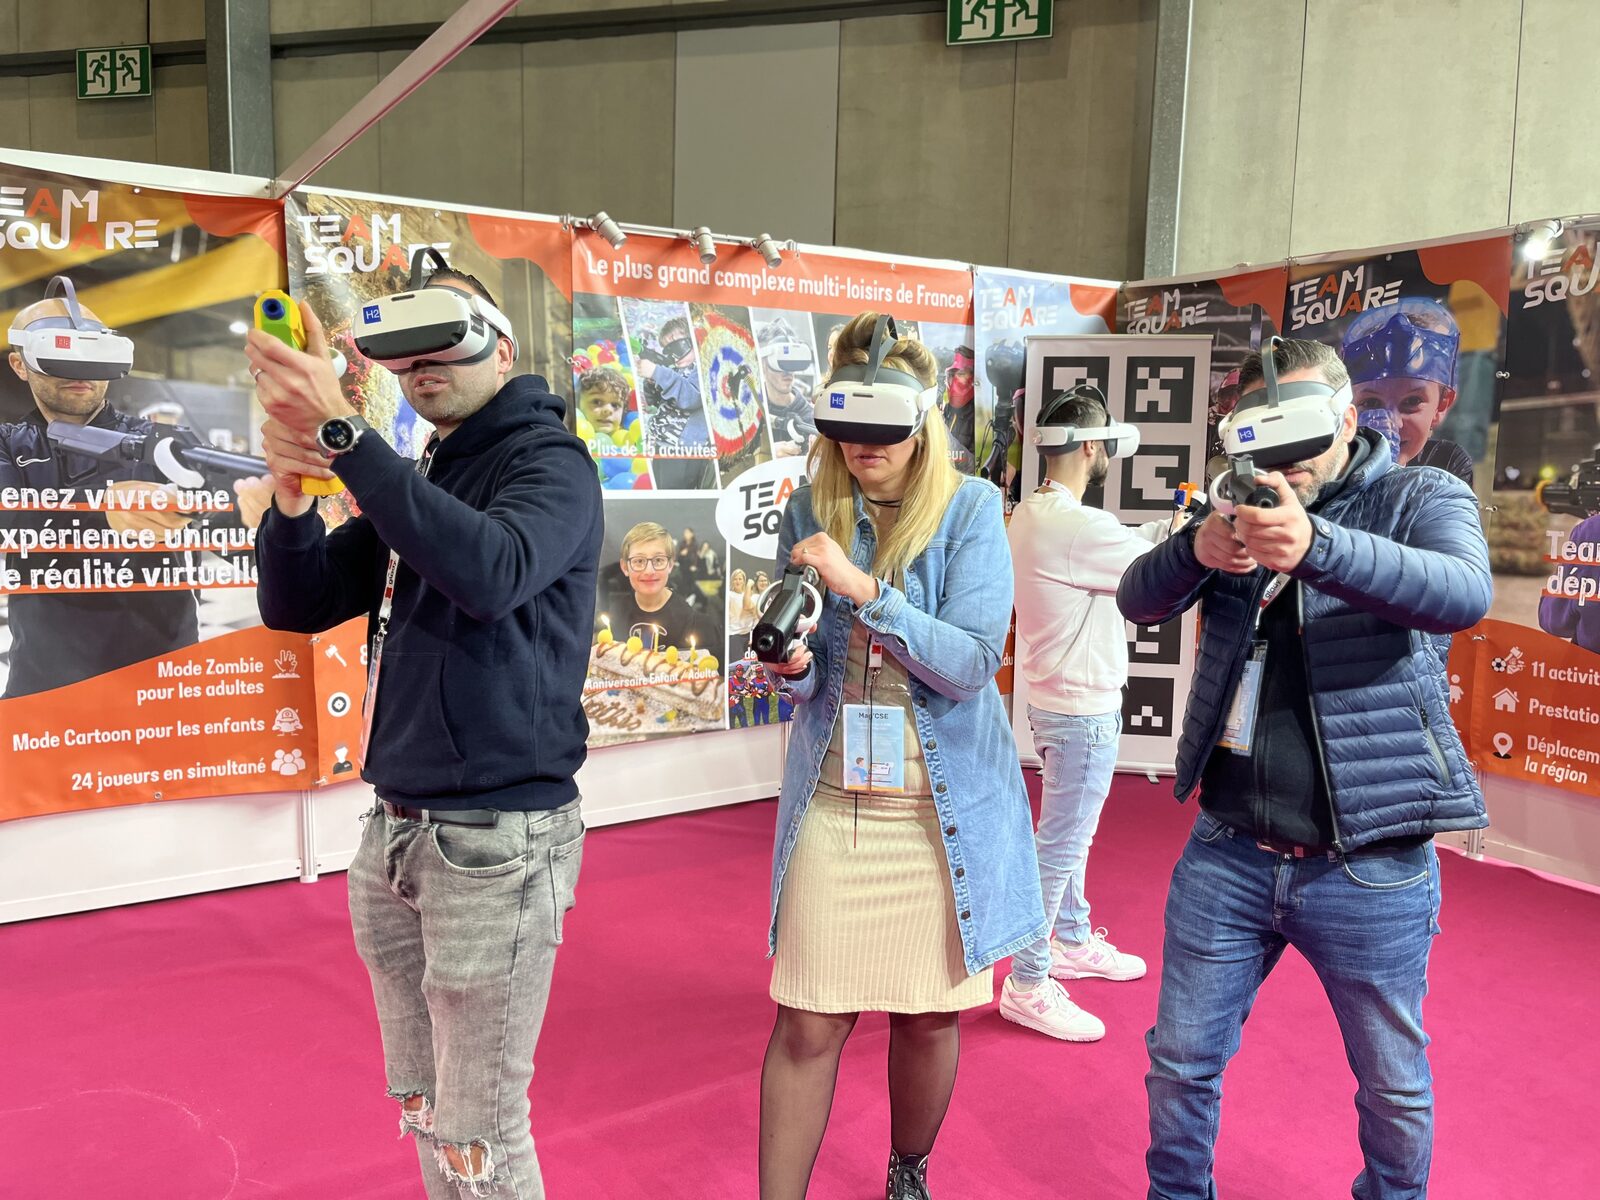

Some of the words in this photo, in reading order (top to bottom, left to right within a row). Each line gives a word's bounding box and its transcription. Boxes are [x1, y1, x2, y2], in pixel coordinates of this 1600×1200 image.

[0, 219, 160, 250] QUARE
[297, 213, 401, 243] TEAM
[587, 252, 608, 275] Le
[613, 257, 653, 284] plus
[657, 263, 710, 288] grand
[714, 267, 795, 295] complexe
[799, 274, 893, 303] multi-loisirs
[896, 283, 913, 304] de
[917, 284, 965, 309] France
[1290, 265, 1364, 306] TEAM
[979, 285, 1035, 309] TEAM
[1124, 288, 1180, 321] TEAM
[1291, 280, 1403, 331] SQUARE
[365, 309, 380, 320] H2
[981, 306, 1058, 332] SQUARE
[1126, 301, 1209, 334] SQUARE
[831, 396, 845, 406] H5
[588, 440, 618, 456] Plus
[621, 440, 638, 456] de
[641, 441, 656, 457] 15
[659, 441, 718, 457] activités
[1240, 430, 1253, 440] H3
[1, 487, 76, 509] enez
[84, 480, 168, 510] vivre
[177, 489, 230, 510] une
[739, 475, 810, 511] TEA
[0, 519, 155, 559] xpérience
[165, 519, 258, 556] unique
[30, 558, 134, 589] réalité
[158, 660, 202, 678] Mode
[206, 658, 264, 675] Zombie
[585, 678, 648, 690] Anniversaire
[649, 672, 679, 685] Enfant
[1531, 660, 1545, 679] 11
[137, 687, 174, 705] pour
[178, 683, 202, 699] les
[206, 680, 264, 696] adultes
[1528, 698, 1599, 725] Prestatio
[12, 733, 60, 752] Mode
[64, 727, 131, 746] Cartoon
[136, 727, 172, 746] pour
[177, 721, 201, 737] les
[204, 717, 266, 734] enfants
[1527, 735, 1600, 765] Déplacem
[72, 773, 93, 791] 24
[97, 770, 160, 792] joueurs
[163, 768, 183, 782] en
[187, 757, 267, 779] simultané
[1524, 756, 1538, 773] la
[1540, 762, 1588, 785] région
